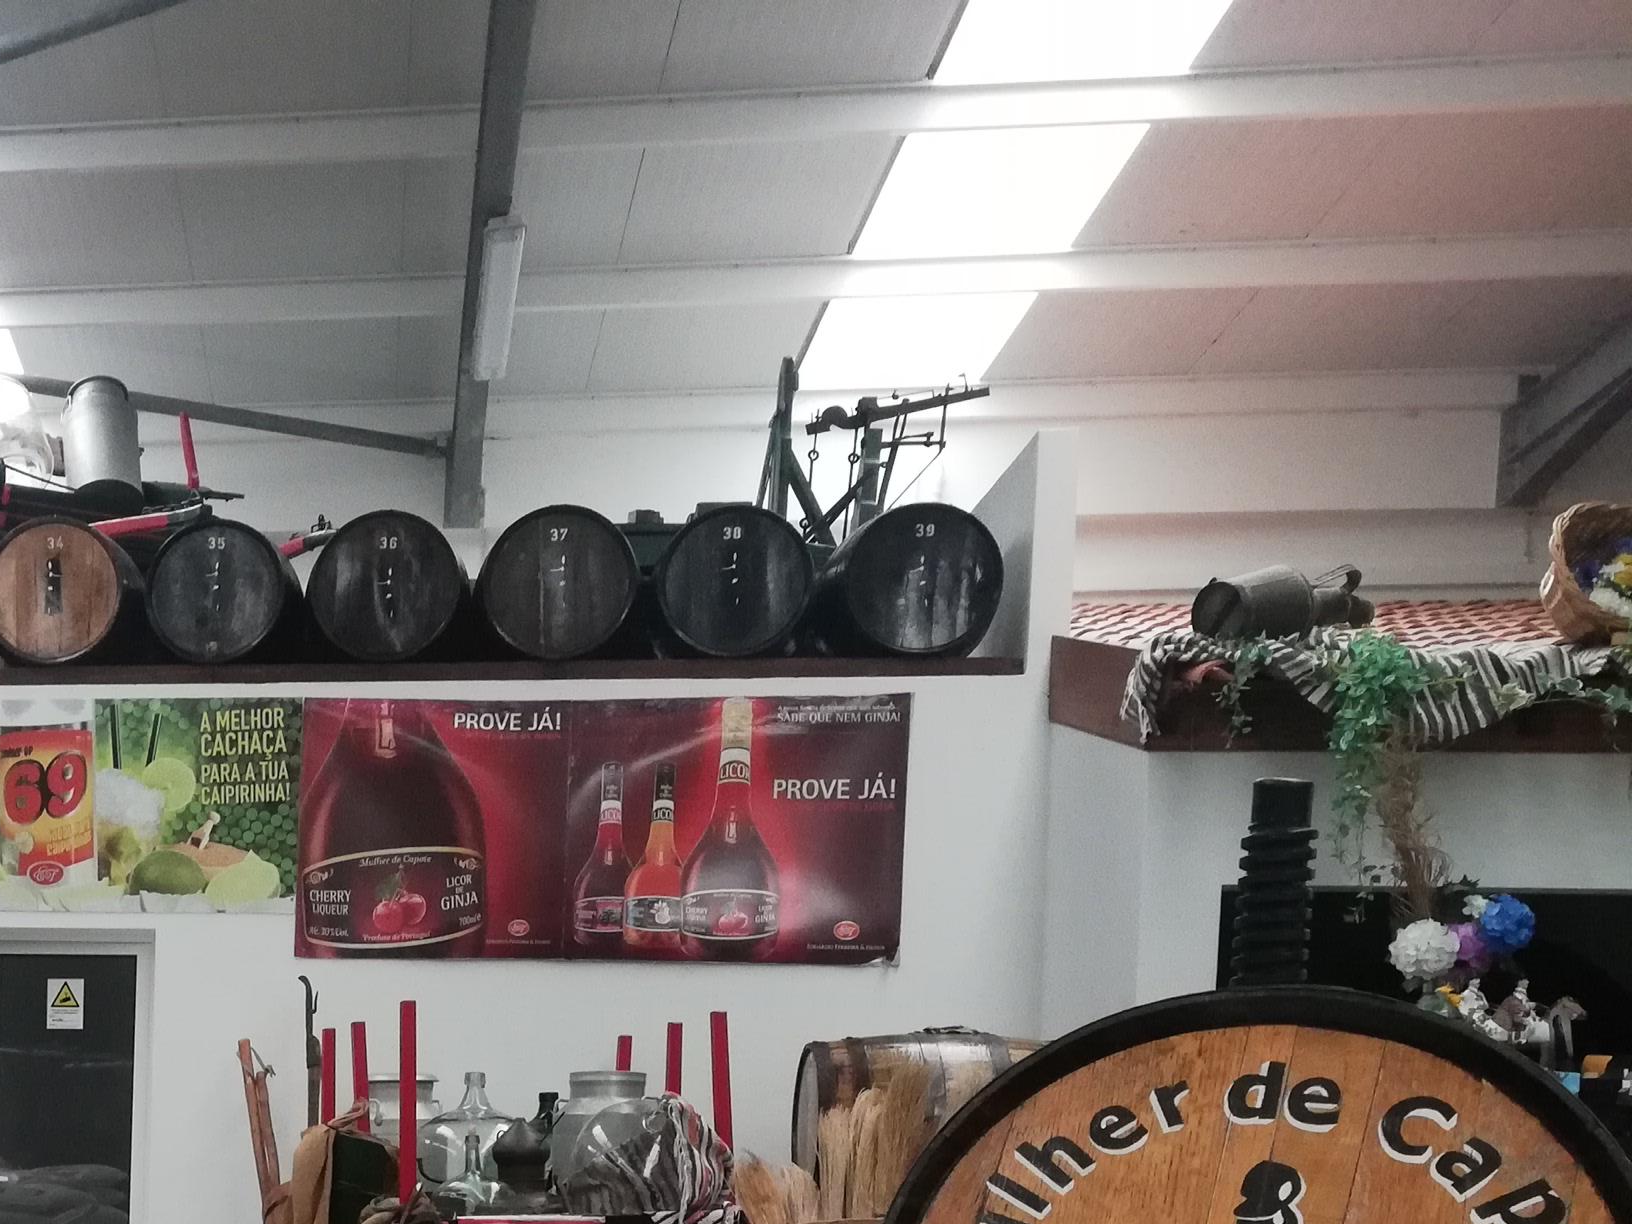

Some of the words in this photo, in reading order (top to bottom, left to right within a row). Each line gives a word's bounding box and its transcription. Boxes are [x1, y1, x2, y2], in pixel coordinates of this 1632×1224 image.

[550, 528, 568, 541] 37
[916, 523, 935, 537] 39
[47, 536, 64, 550] 34
[208, 537, 225, 550] 35
[379, 536, 398, 550] 36
[200, 711, 211, 732] A
[216, 707, 284, 731] MELHOR
[454, 712, 522, 731] PROVE
[528, 706, 561, 731] JÁ!
[808, 712, 832, 724] QUE
[835, 712, 861, 722] NEM
[864, 712, 901, 722] GINJA!
[201, 729, 287, 760] CACHAÇA
[201, 763, 240, 783] PARA
[245, 761, 256, 781] A
[259, 760, 289, 781] TUA
[4, 750, 88, 825] 69
[773, 779, 850, 799] PROVE
[858, 771, 896, 799] JÁ!
[201, 782, 290, 805] CAIPIRINHA!
[391, 855, 401, 864] de
[446, 874, 472, 888] LICOR
[309, 889, 352, 903] CHERRY
[441, 891, 479, 911] GINJA
[312, 903, 349, 916] LIQUEUR
[1223, 1061, 1343, 1134] de
